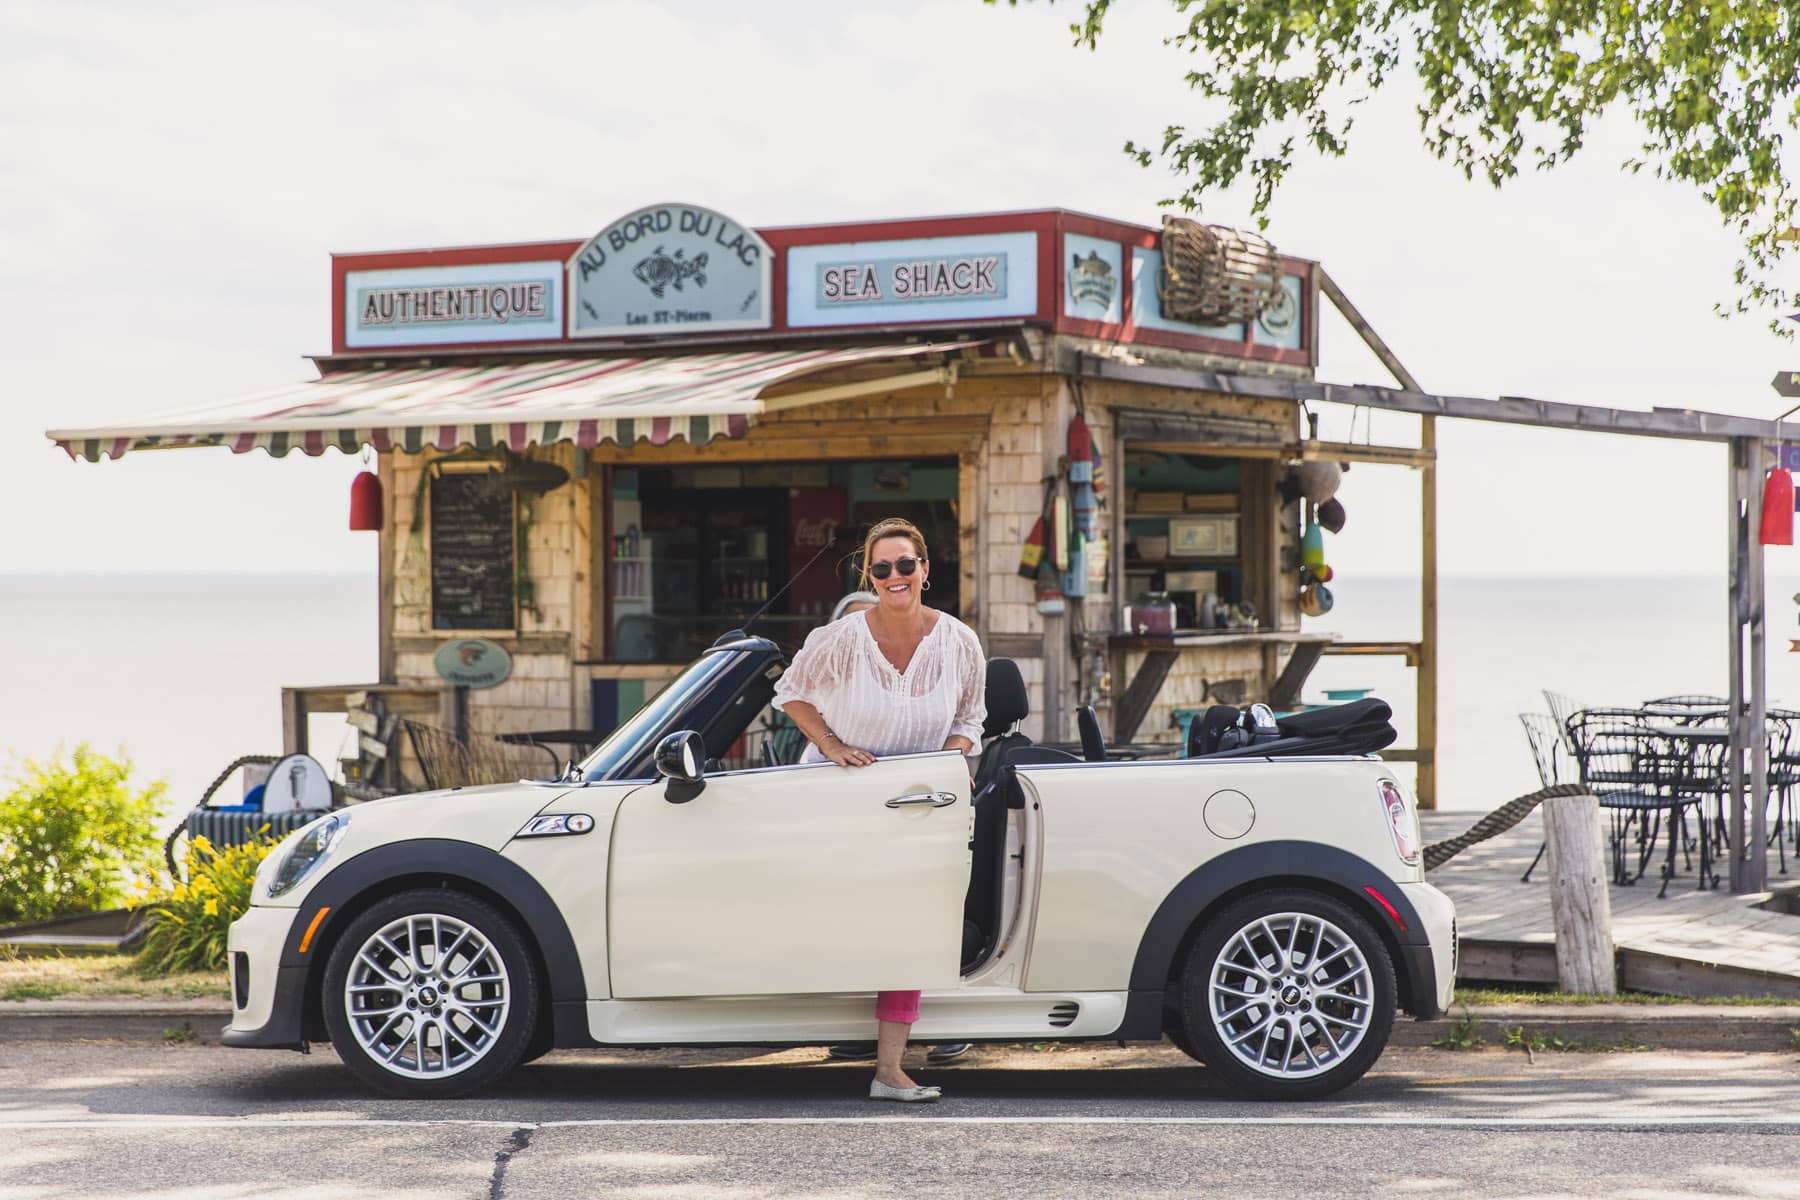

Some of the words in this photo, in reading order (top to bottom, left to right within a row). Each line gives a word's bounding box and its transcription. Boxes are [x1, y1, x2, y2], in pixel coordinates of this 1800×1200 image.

[579, 244, 606, 282] AU
[608, 210, 672, 252] BORD
[679, 210, 713, 237] DU
[715, 223, 760, 267] LAC
[823, 264, 881, 300] SEA
[893, 257, 998, 298] SHACK
[363, 283, 546, 324] AUTHENTIQUE
